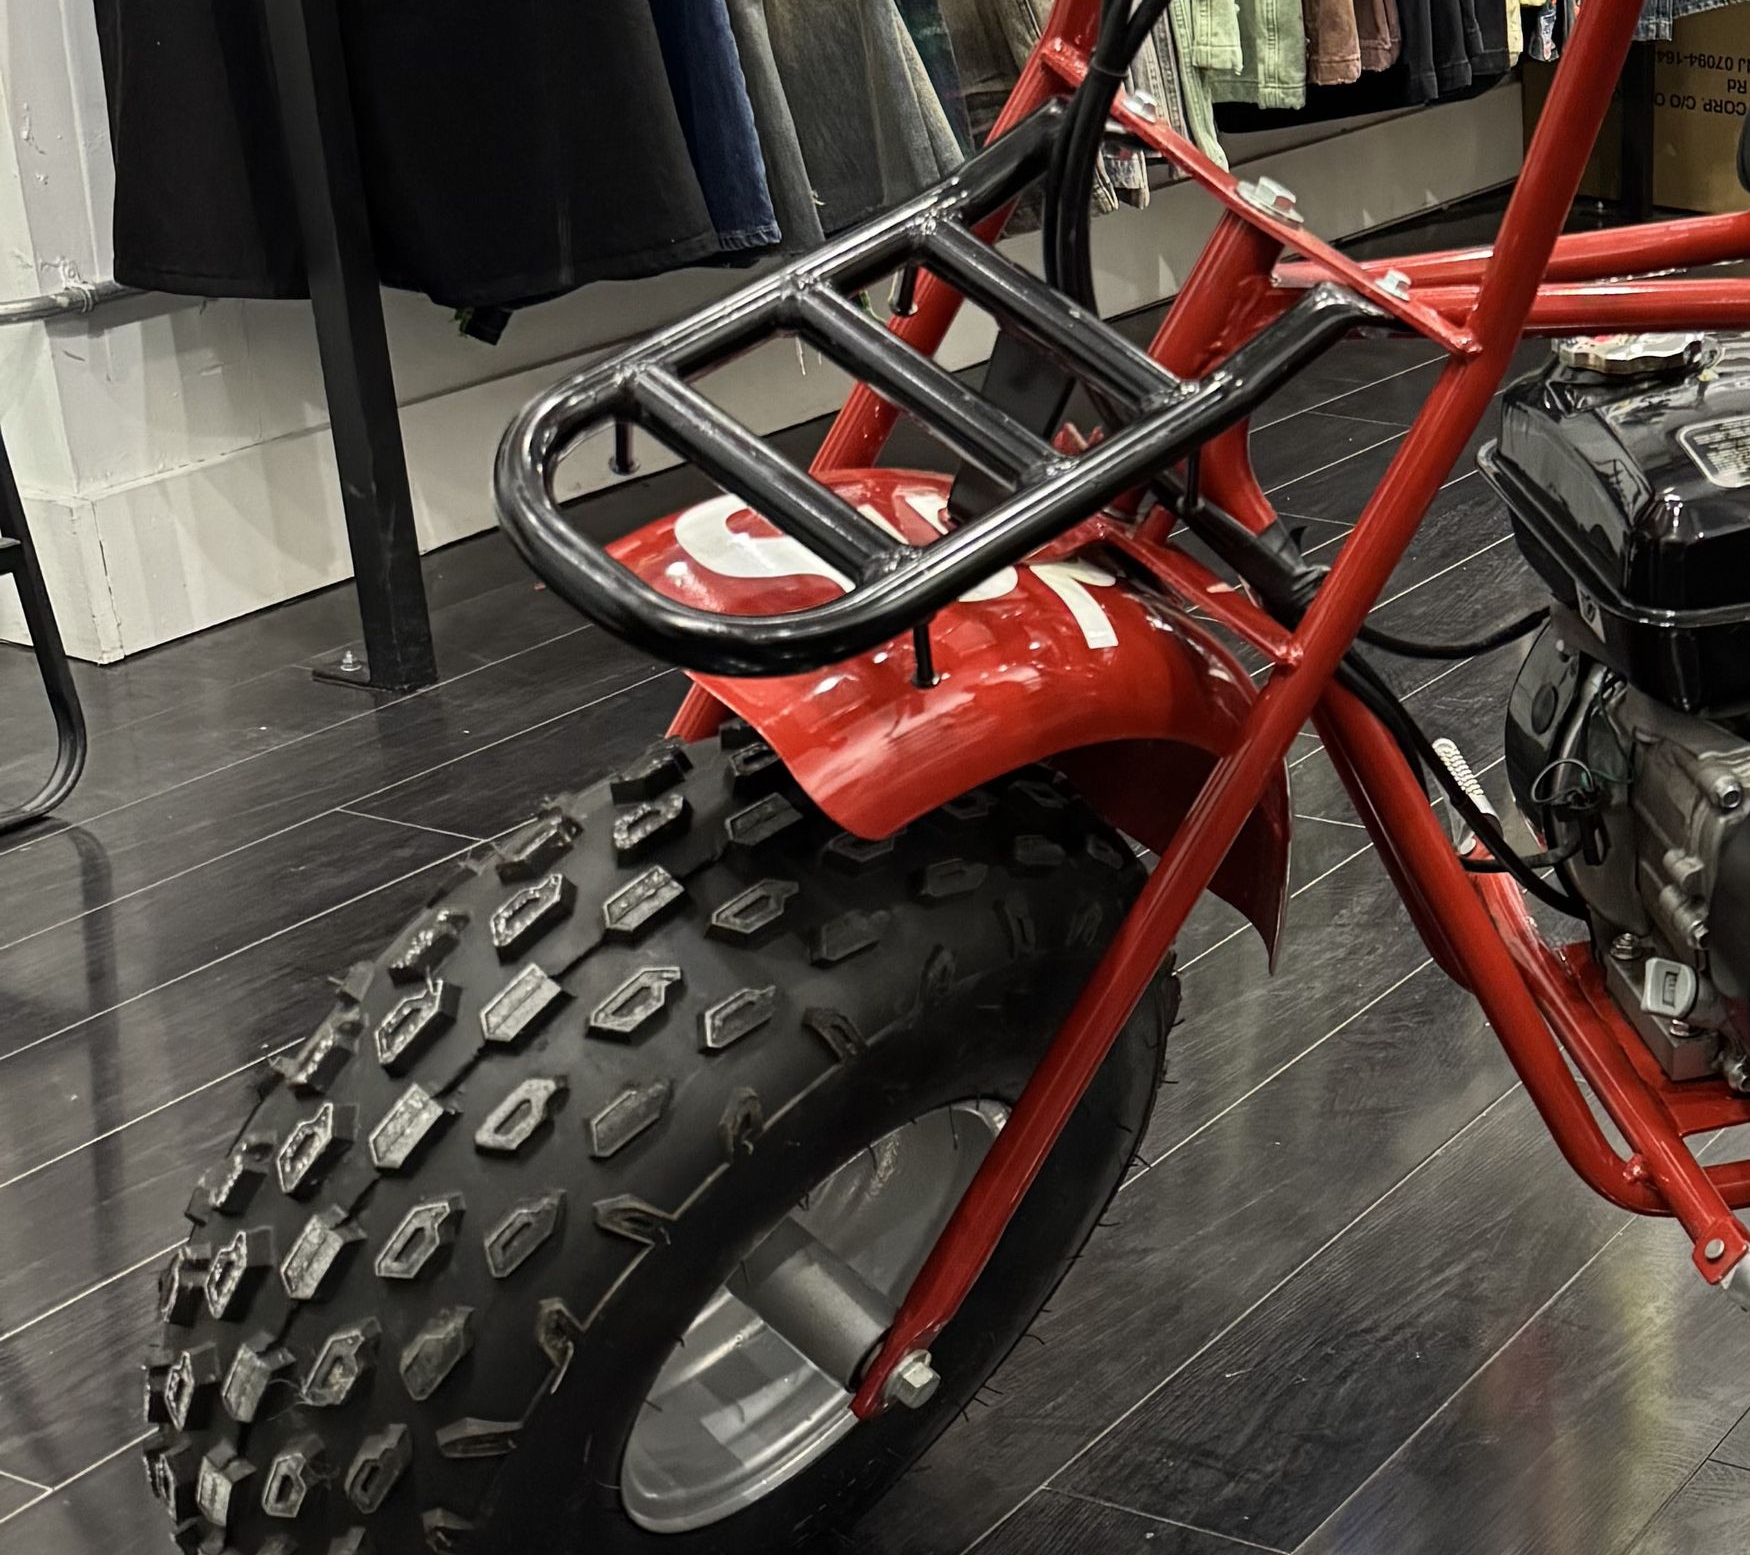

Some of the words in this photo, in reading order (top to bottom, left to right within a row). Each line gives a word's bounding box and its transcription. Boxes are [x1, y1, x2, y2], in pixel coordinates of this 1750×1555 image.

[1727, 78, 1748, 94] Rd
[1669, 94, 1697, 111] C/O
[1701, 97, 1747, 116] CORP.
